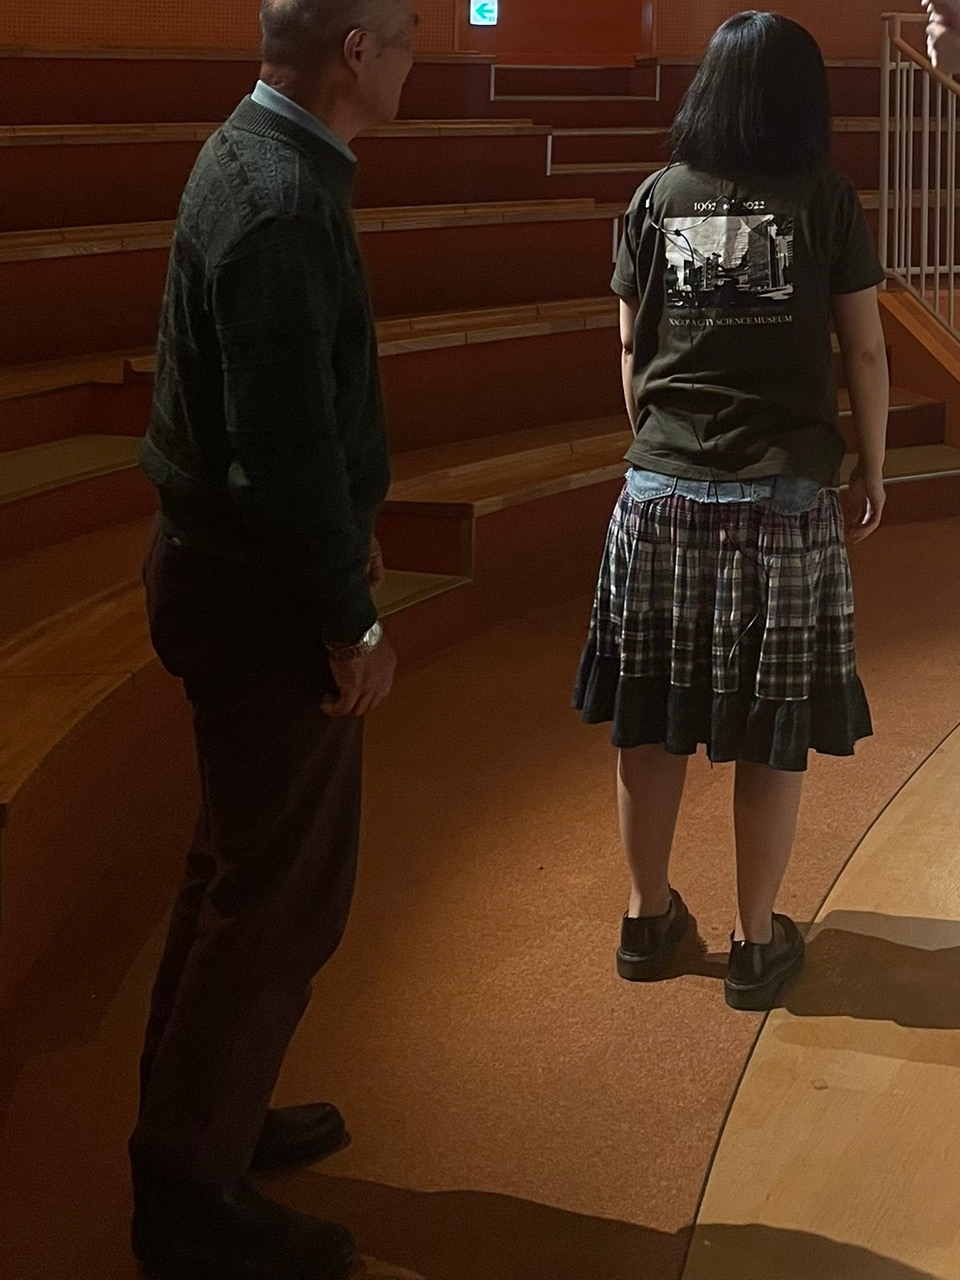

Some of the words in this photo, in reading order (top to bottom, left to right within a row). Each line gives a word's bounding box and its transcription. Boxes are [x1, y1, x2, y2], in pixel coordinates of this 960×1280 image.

[694, 200, 716, 213] 1962
[716, 317, 752, 325] SCIENCE
[753, 315, 792, 324] MUSEUM
